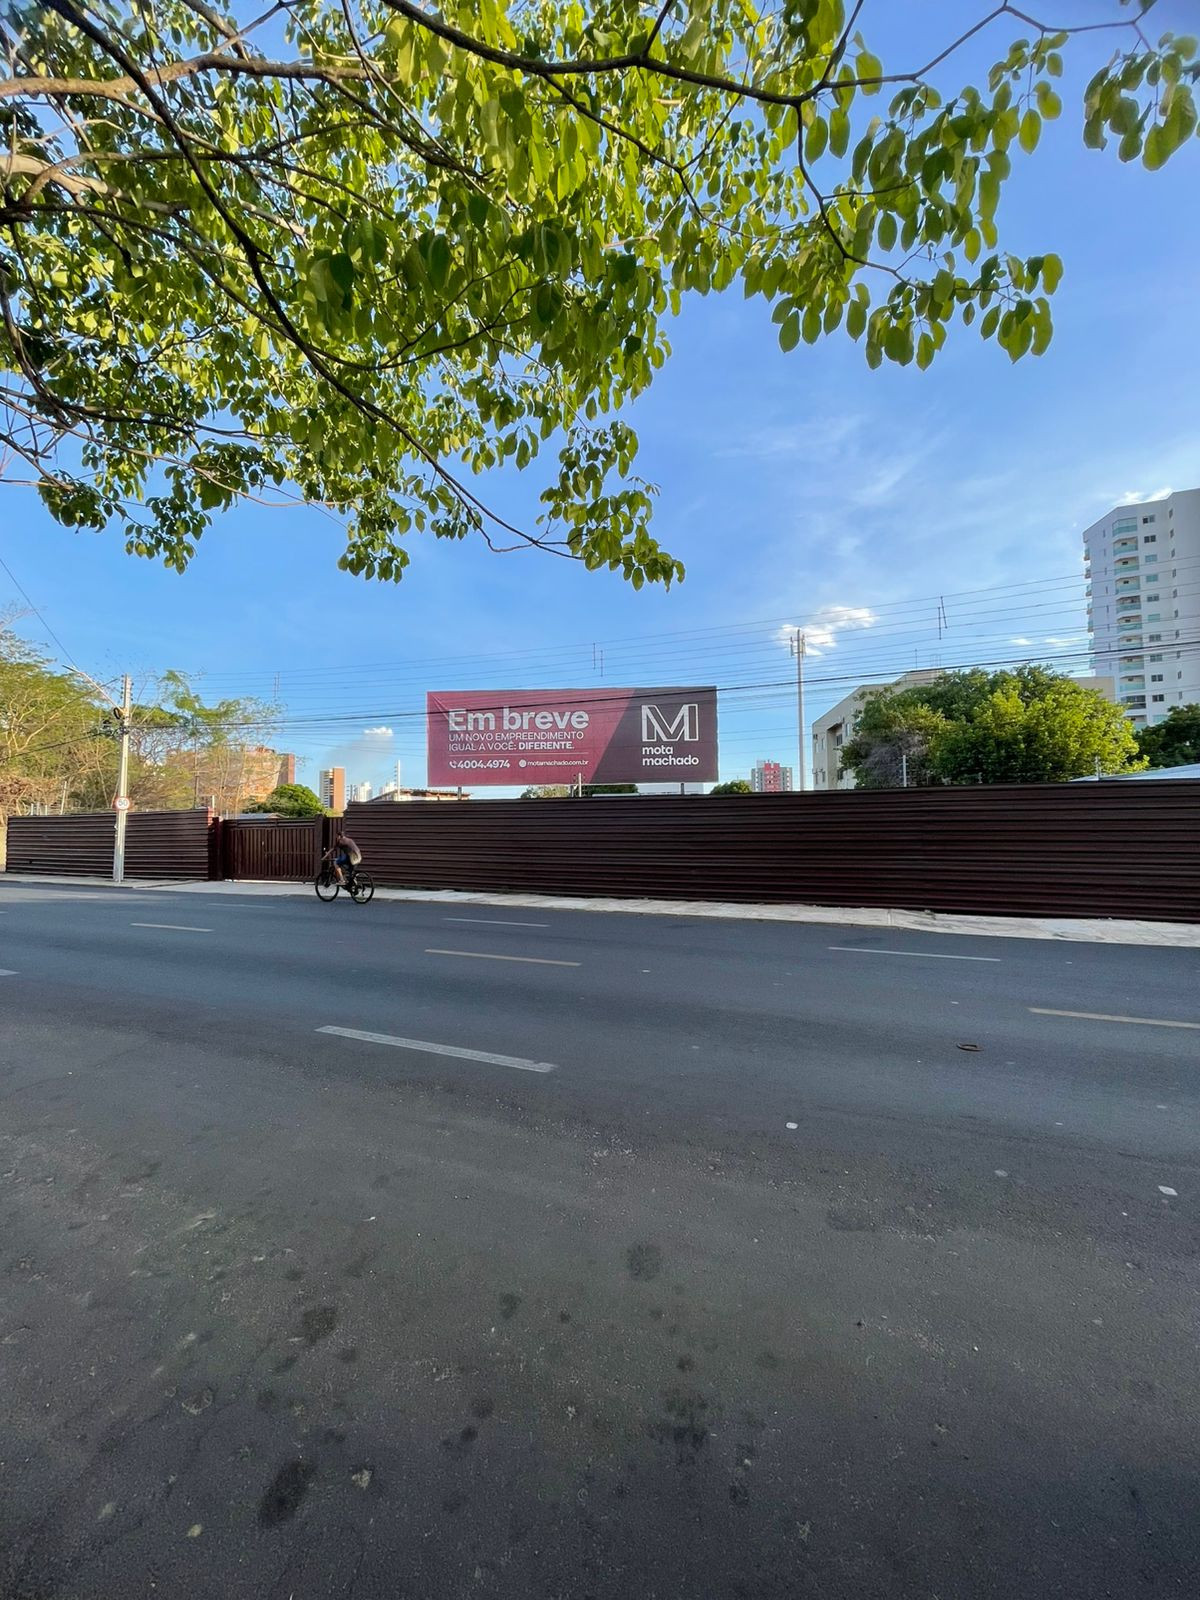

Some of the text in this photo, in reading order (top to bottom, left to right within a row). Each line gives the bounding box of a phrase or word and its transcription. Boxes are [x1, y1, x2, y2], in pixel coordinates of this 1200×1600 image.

[448, 706, 589, 731] Em breve
[449, 731, 584, 742] UM NOVO EMPREENDIMENTO
[449, 740, 575, 752] IGUAL A VOCÊ: DIFERENTE.
[642, 745, 674, 755] mota
[457, 759, 511, 769] 4004.4974
[642, 755, 700, 766] machado
